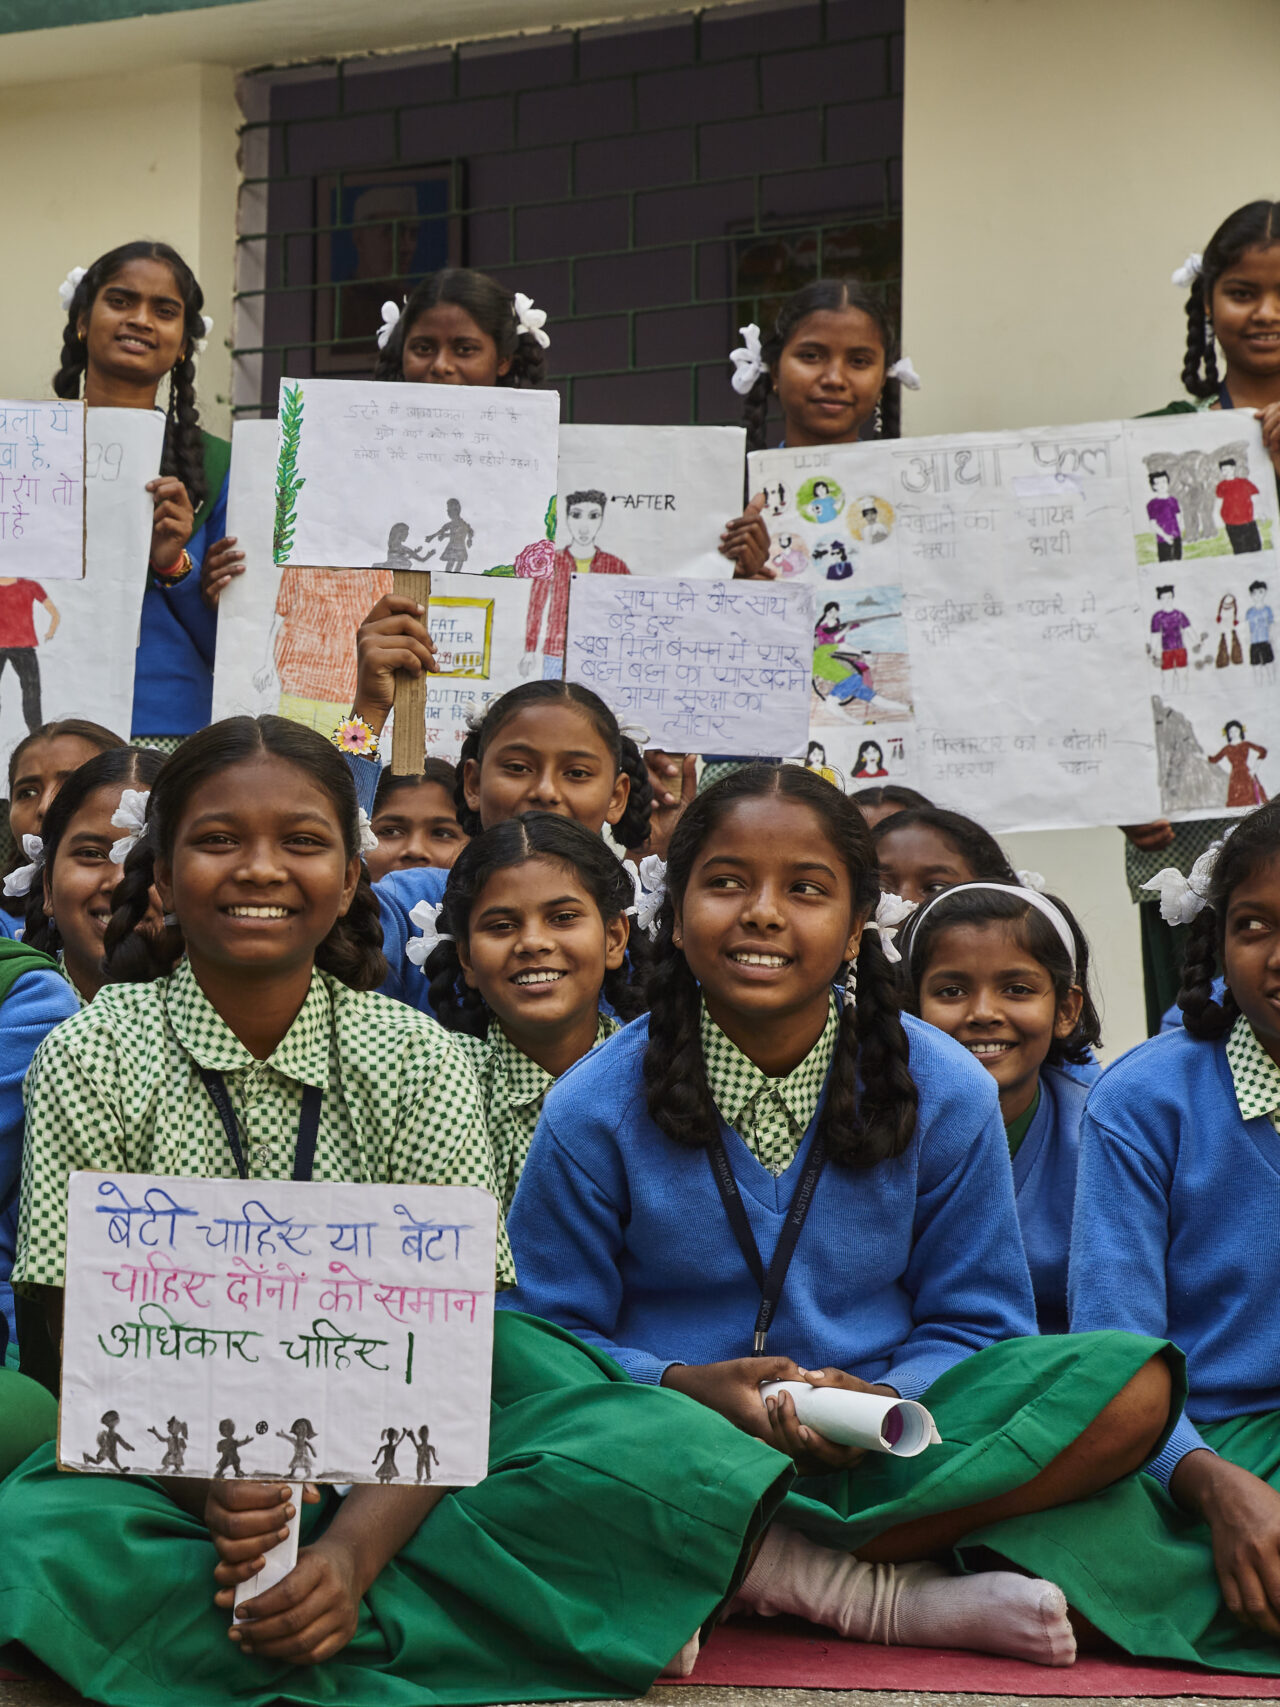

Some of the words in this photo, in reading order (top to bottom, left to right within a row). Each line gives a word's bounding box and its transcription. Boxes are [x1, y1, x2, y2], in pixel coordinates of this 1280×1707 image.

[50, 403, 72, 434] ये
[14, 474, 40, 504] रंग
[52, 472, 80, 505] तो
[623, 494, 676, 511] AFTER
[12, 505, 30, 540] है
[707, 582, 743, 614] और
[430, 632, 474, 644] UTTER
[431, 618, 458, 630] FAT
[791, 1168, 818, 1225] KASTURBA
[96, 1181, 199, 1250] बेटी
[326, 1222, 379, 1258] या
[393, 1204, 475, 1263] बेटा
[318, 1260, 373, 1313] को
[374, 1284, 490, 1324] समान
[98, 1302, 264, 1362] अधिकार
